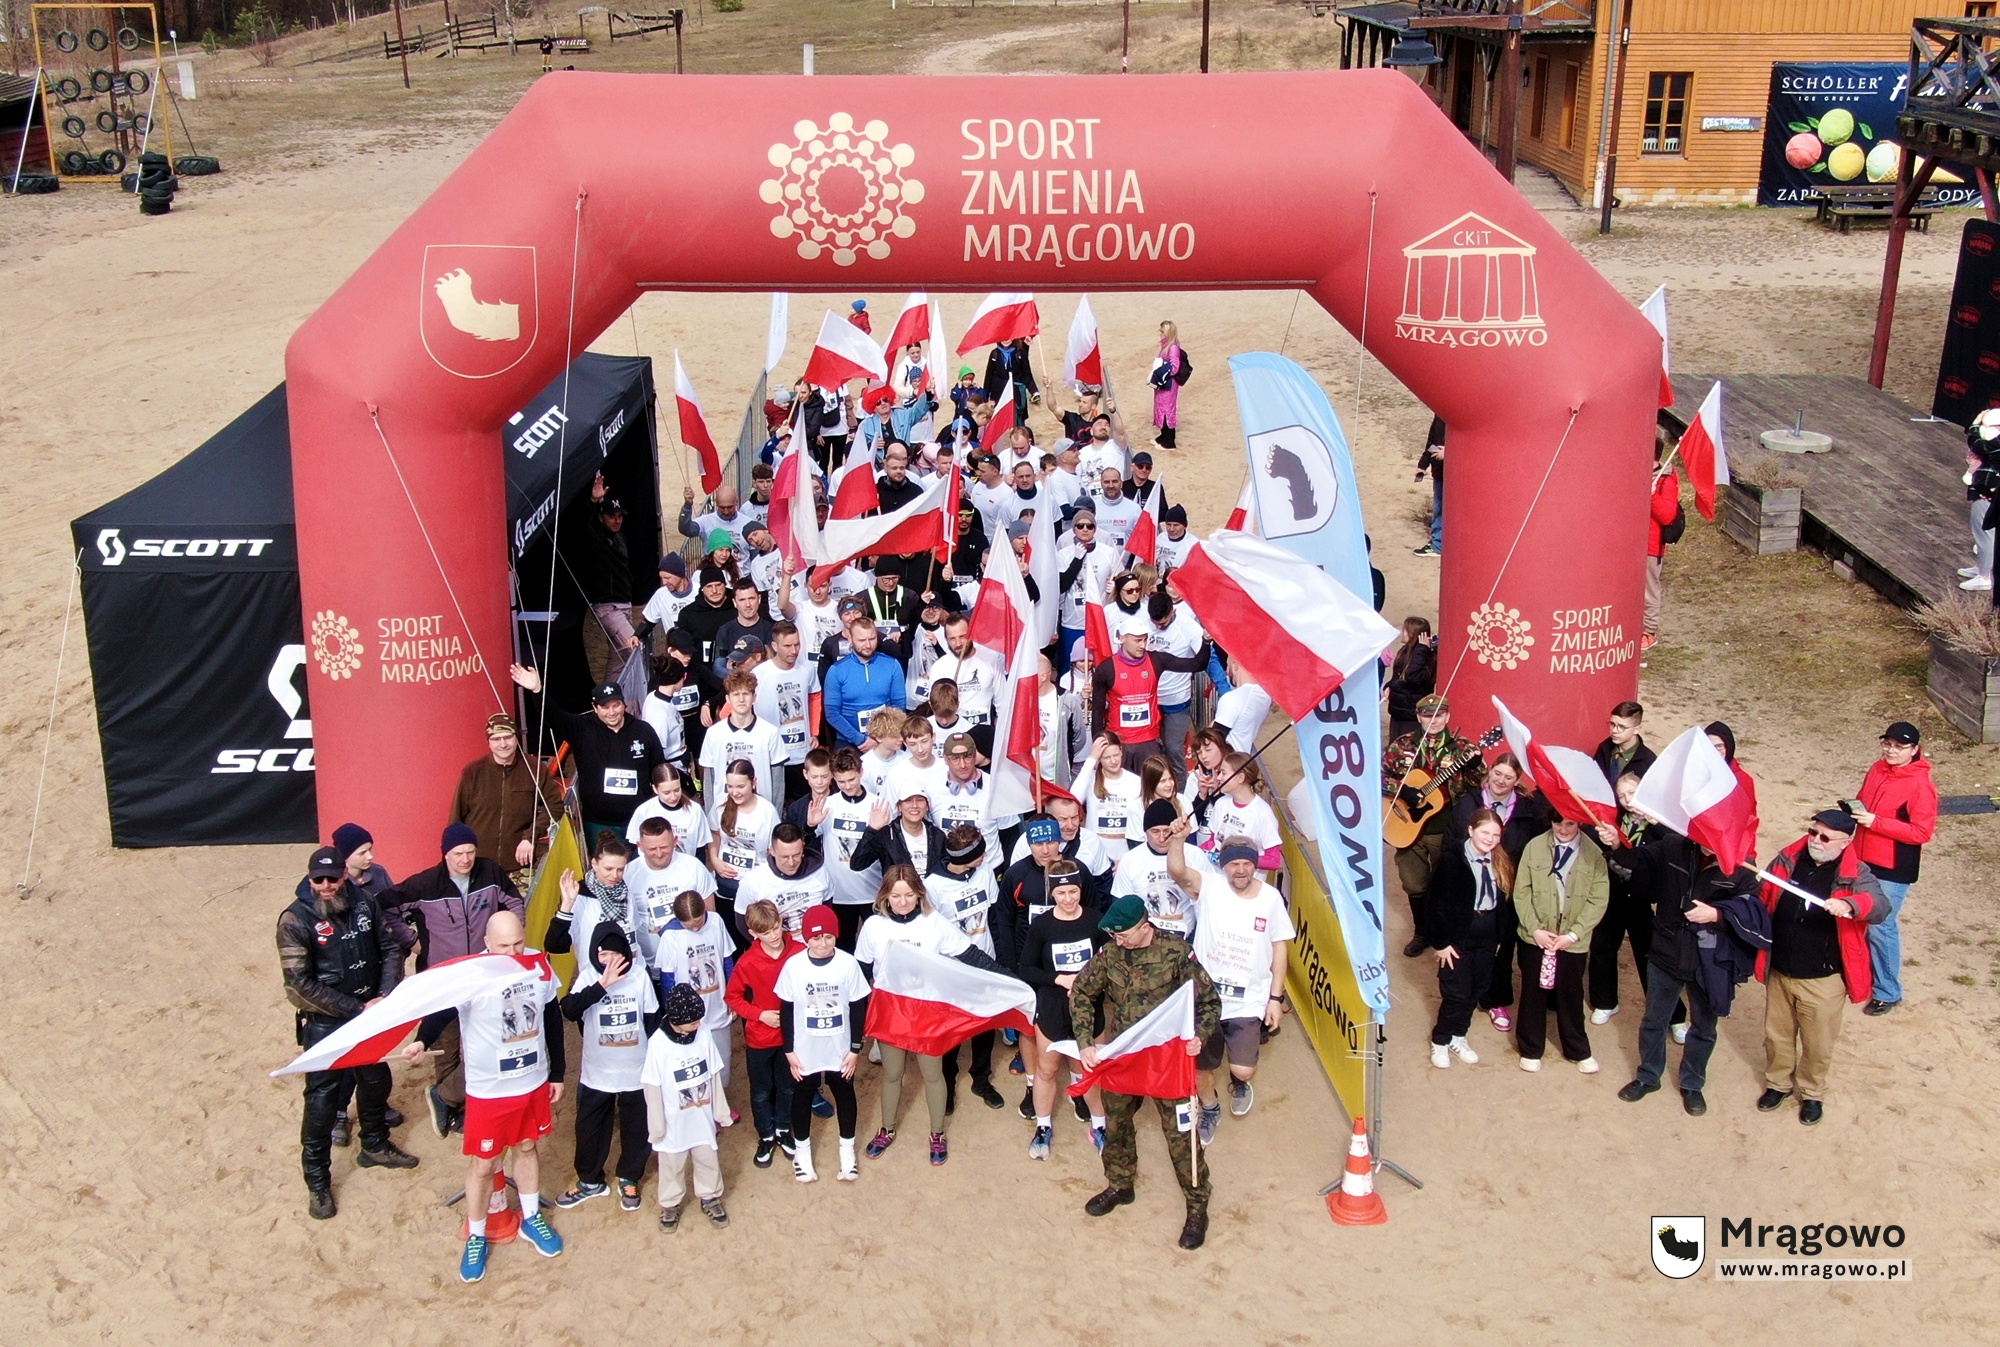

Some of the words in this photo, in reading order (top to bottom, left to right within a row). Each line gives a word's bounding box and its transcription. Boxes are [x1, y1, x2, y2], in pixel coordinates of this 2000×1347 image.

[961, 118, 1101, 160] SPORT
[961, 170, 1144, 214] ZMIENIA
[1932, 189, 1975, 202] ODY
[963, 223, 1196, 268] MRĄGOWO
[1394, 324, 1548, 348] MRĄGOWO
[513, 404, 570, 460] SCOTT
[605, 409, 625, 444] SCOTT
[524, 490, 556, 541] SCOTT
[129, 538, 273, 557] SCOTT
[1552, 605, 1612, 630] SPORT
[378, 615, 442, 638] SPORT
[1550, 624, 1623, 652] ZMIENIA
[379, 636, 462, 660] ZMIENIA
[1550, 640, 1634, 675] MRĄGOWO
[382, 654, 483, 685] MRĄGOWO
[923, 687, 929, 696] 7
[679, 696, 692, 704] 23
[968, 716, 980, 725] 98
[1129, 713, 1142, 721] 77
[788, 734, 800, 743] 79
[211, 748, 316, 774] SCO
[615, 778, 629, 787] 29
[842, 821, 857, 830] 49
[1107, 818, 1122, 827] 96
[1030, 825, 1052, 837] 21.1
[728, 855, 747, 868] 102
[964, 895, 979, 908] 73
[1066, 952, 1082, 963] 26
[1294, 906, 1358, 1055] Mrągowo
[1220, 985, 1235, 996] 18
[610, 1015, 627, 1025] 38
[817, 1018, 833, 1028] 85
[515, 1058, 525, 1069] 2
[685, 1066, 701, 1079] 39
